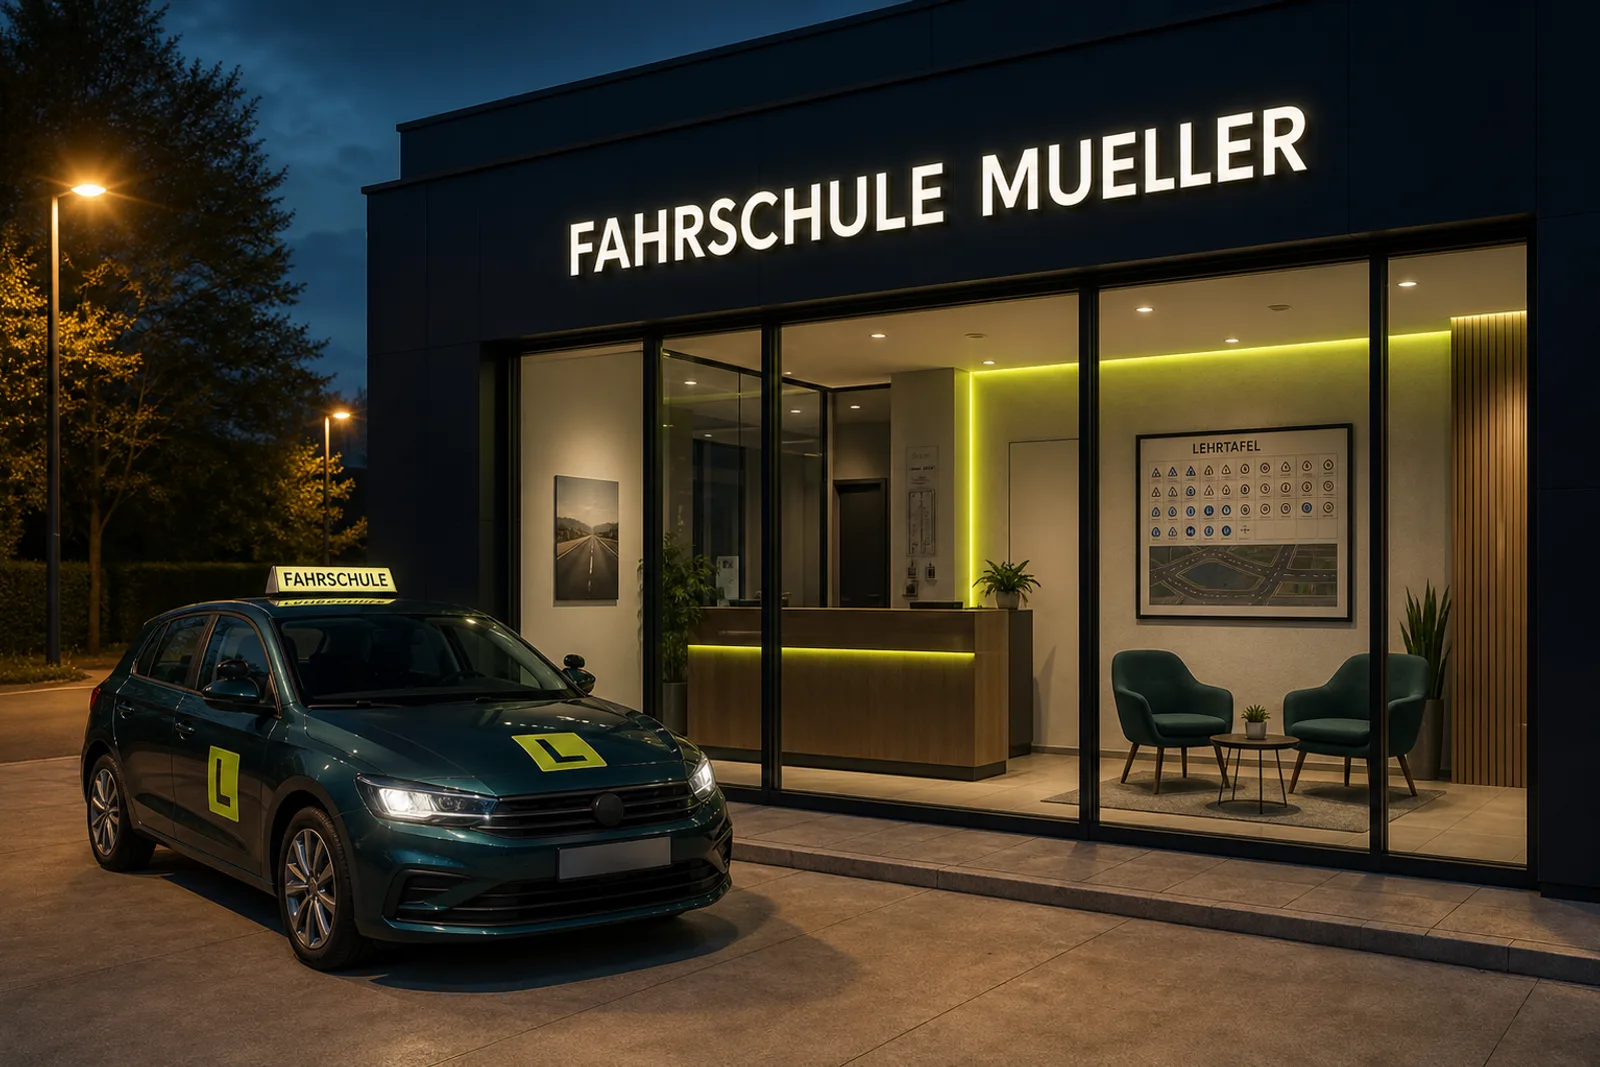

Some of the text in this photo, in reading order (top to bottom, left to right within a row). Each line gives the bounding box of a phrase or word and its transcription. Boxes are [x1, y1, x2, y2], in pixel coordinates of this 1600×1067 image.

[569, 105, 1308, 277] FAHRSCHULE MUELLER
[1192, 440, 1261, 454] LEHRTAFEL
[283, 572, 389, 588] FAHRSCHULE
[535, 739, 588, 764] L
[215, 757, 232, 808] L
